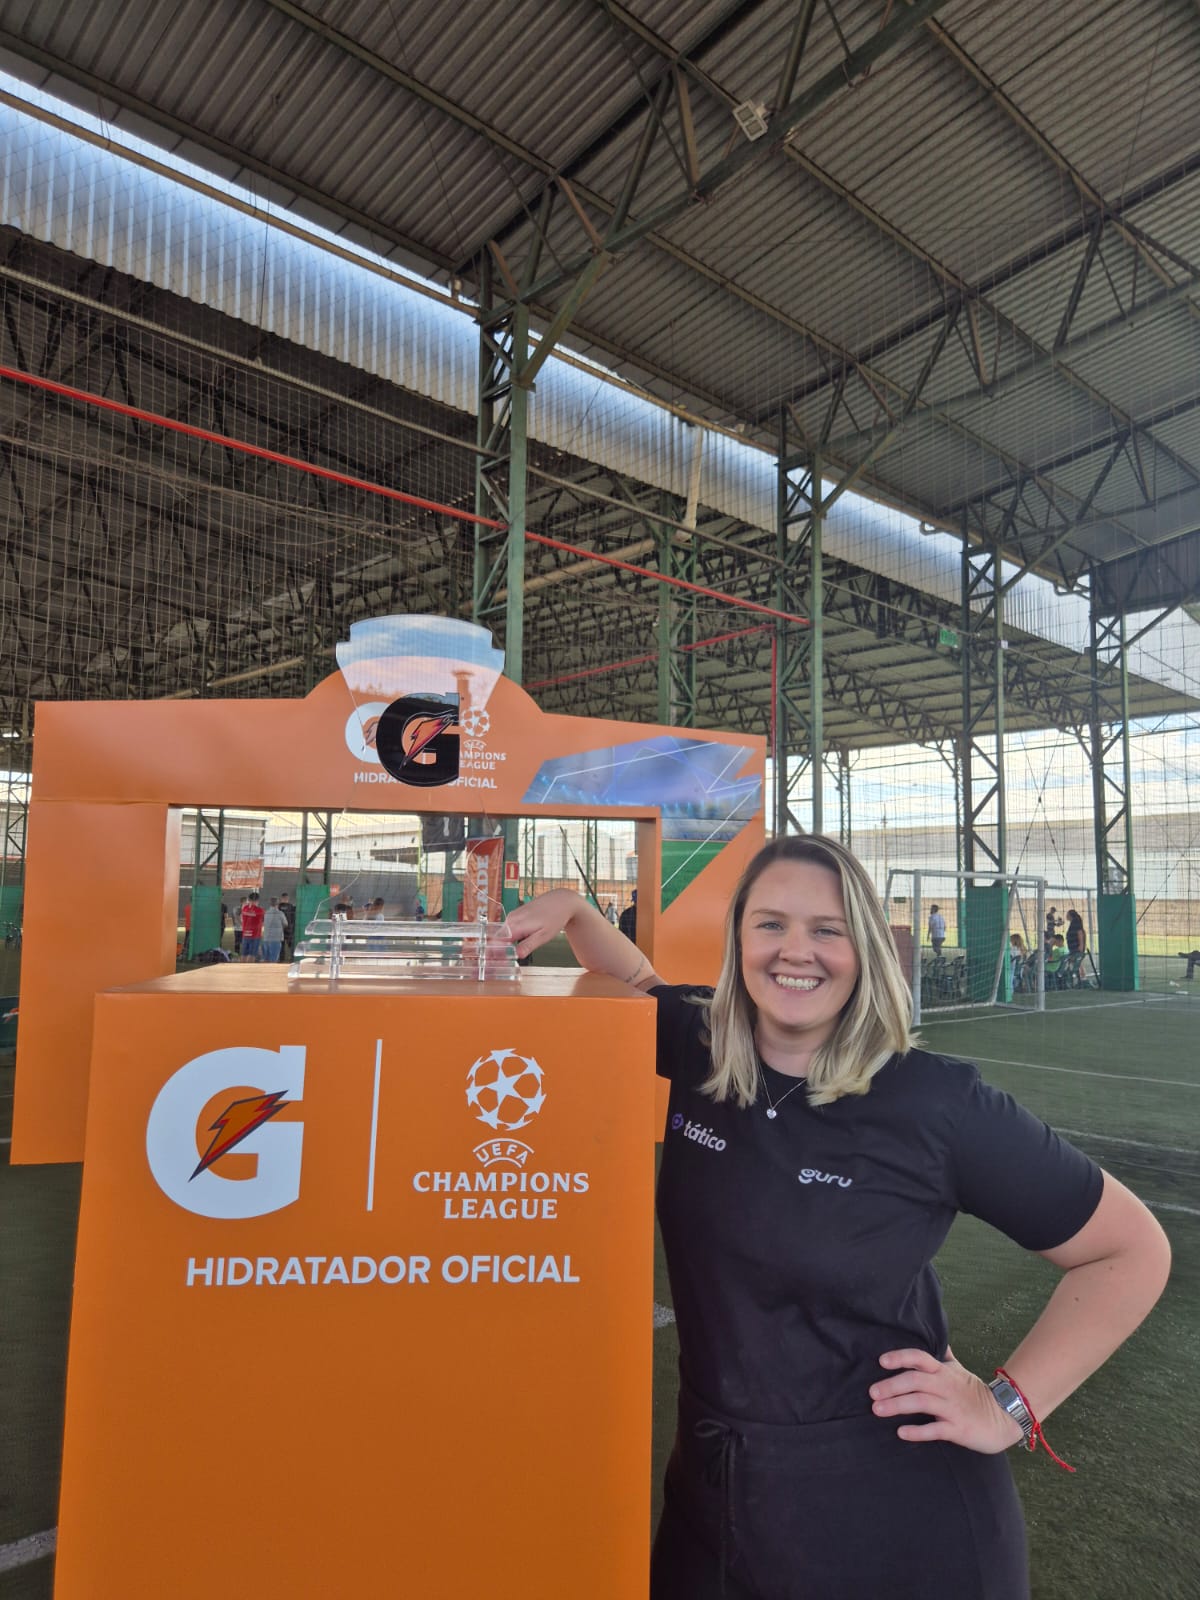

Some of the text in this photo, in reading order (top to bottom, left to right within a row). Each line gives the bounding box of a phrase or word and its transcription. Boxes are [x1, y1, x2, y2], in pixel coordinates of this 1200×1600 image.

[376, 692, 460, 787] G
[459, 751, 507, 761] MPIONS
[459, 761, 496, 770] EAGUE
[354, 772, 398, 784] HIDRA
[146, 1045, 306, 1220] G
[683, 1120, 727, 1151] tático
[475, 1143, 528, 1164] UEFA
[413, 1171, 589, 1193] CHAMPIONS
[798, 1168, 852, 1187] guru
[444, 1198, 558, 1219] LEAGUE
[186, 1255, 580, 1286] HIDRATADOR OFICIAL
